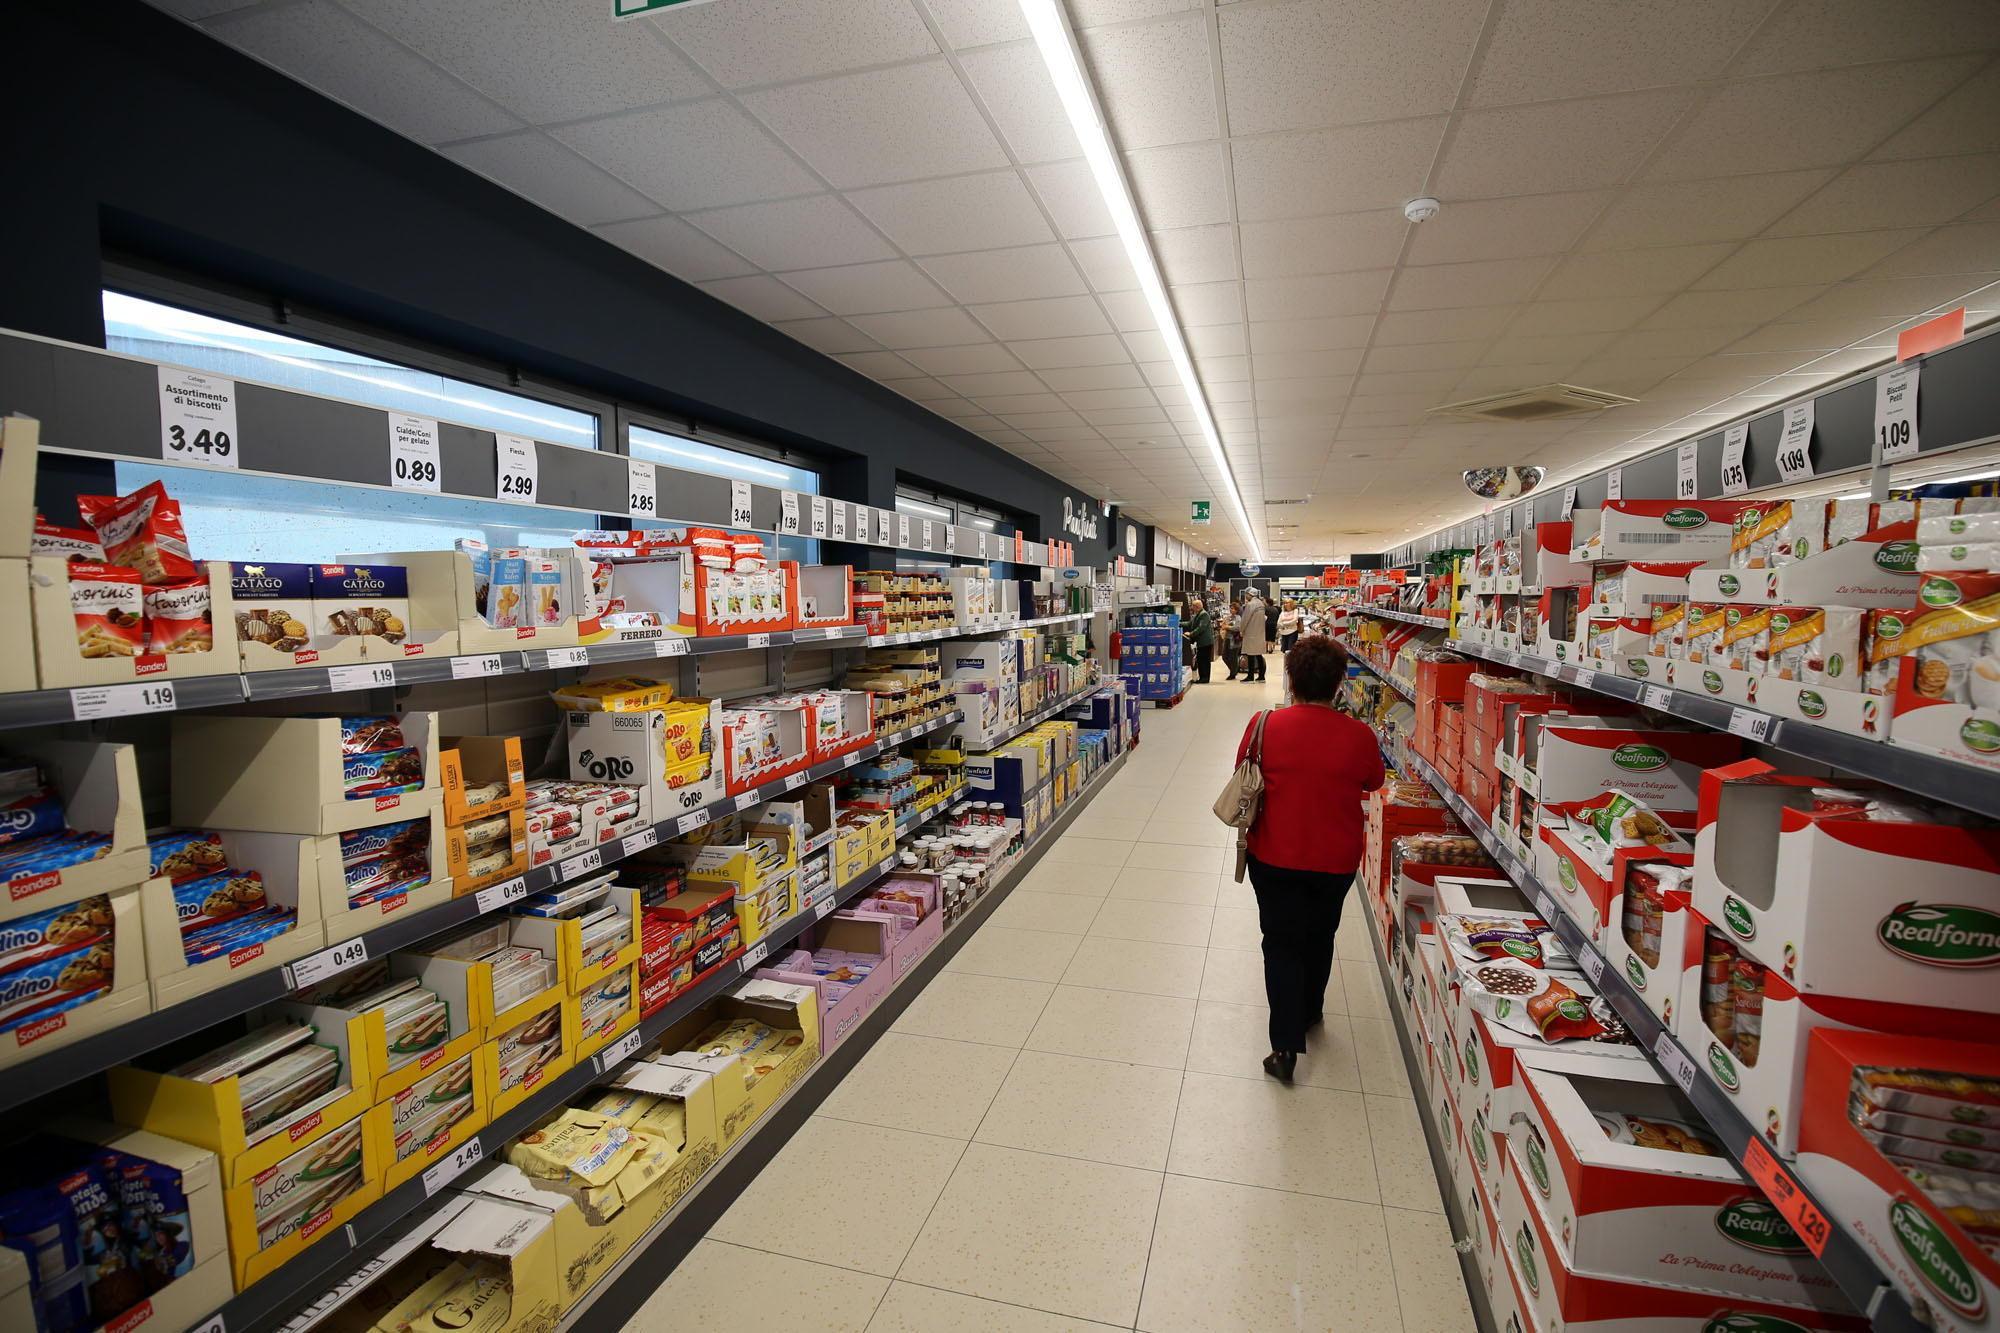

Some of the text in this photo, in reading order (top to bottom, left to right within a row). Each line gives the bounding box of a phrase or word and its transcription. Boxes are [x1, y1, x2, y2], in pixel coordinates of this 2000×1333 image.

[164, 384, 229, 403] Assortimento
[1886, 383, 1908, 397] Biscotti
[1889, 392, 1903, 404] Petit
[174, 396, 222, 411] di biscotti
[169, 424, 231, 457] 3.49
[396, 425, 432, 439] Cialde/Coni
[398, 434, 430, 446] per gelato
[1880, 419, 1910, 450] 1.09
[509, 447, 526, 456] Fiesta
[1780, 448, 1804, 474] 1.09
[395, 457, 436, 482] 0.89
[1723, 464, 1743, 487] 0.75
[502, 474, 533, 496] 2.99
[1680, 477, 1694, 497] 1.19
[631, 493, 654, 511] 2.85
[734, 508, 751, 523] 3.49
[784, 516, 797, 529] 1.39
[1664, 511, 1706, 526] Realforno
[33, 538, 94, 553] orinis
[322, 566, 345, 576] Sondey
[232, 578, 283, 589] CATAGO
[343, 580, 385, 590] CATAGO
[516, 629, 535, 639] Sondey
[620, 629, 662, 641] FERRERO
[295, 651, 320, 663] Sondey
[404, 645, 425, 656] Sondey
[569, 650, 588, 664] 0.85
[671, 642, 685, 654] 3.89
[136, 661, 167, 680] Sondey
[482, 659, 500, 672] 1.79
[372, 668, 393, 684] 1.19
[142, 687, 172, 706] 1.19
[613, 716, 644, 729] 660065
[666, 724, 687, 740] ORO
[1750, 717, 1766, 737] 1.09
[1614, 750, 1665, 767] Realforno
[344, 765, 377, 779] ndino
[589, 756, 634, 781] ORO
[1600, 780, 1680, 793] La Prima Colazione
[376, 797, 401, 812] Sondey
[683, 790, 703, 808] ORO
[643, 831, 657, 845] 1.79
[582, 852, 601, 870] 0.49
[12, 874, 60, 898] Sondey
[344, 867, 378, 887] ndino
[502, 880, 525, 899] 0.49
[383, 894, 408, 913] Sondey
[1723, 903, 1753, 931] Realforno
[231, 945, 265, 967] Sondey
[333, 943, 365, 968] 0.49
[642, 940, 671, 967] Loacker
[698, 938, 722, 963] Loacker
[1505, 941, 1540, 958] Realforno
[602, 954, 619, 971] Sondey
[642, 976, 670, 1002] Loacker
[18, 1016, 65, 1045] Sondey
[600, 1022, 617, 1039] Sondey
[623, 1035, 641, 1053] 2.49
[420, 1046, 445, 1070] Sondey
[1709, 1048, 1736, 1087] Realforno
[524, 1070, 544, 1090] Sondey
[393, 1095, 430, 1127] afer
[290, 1114, 321, 1141] Sondey
[539, 1118, 608, 1154] Tarallucci
[427, 1133, 450, 1157] Sondey
[456, 1142, 481, 1168] 2.49
[255, 1172, 303, 1211] afer
[302, 1210, 332, 1240] Sondey
[1798, 1202, 1826, 1245] 1.29
[1892, 1205, 1974, 1302] Realforno
[1659, 1253, 1681, 1268] La
[1683, 1257, 1728, 1275] Prima
[1729, 1262, 1796, 1284] Colazione
